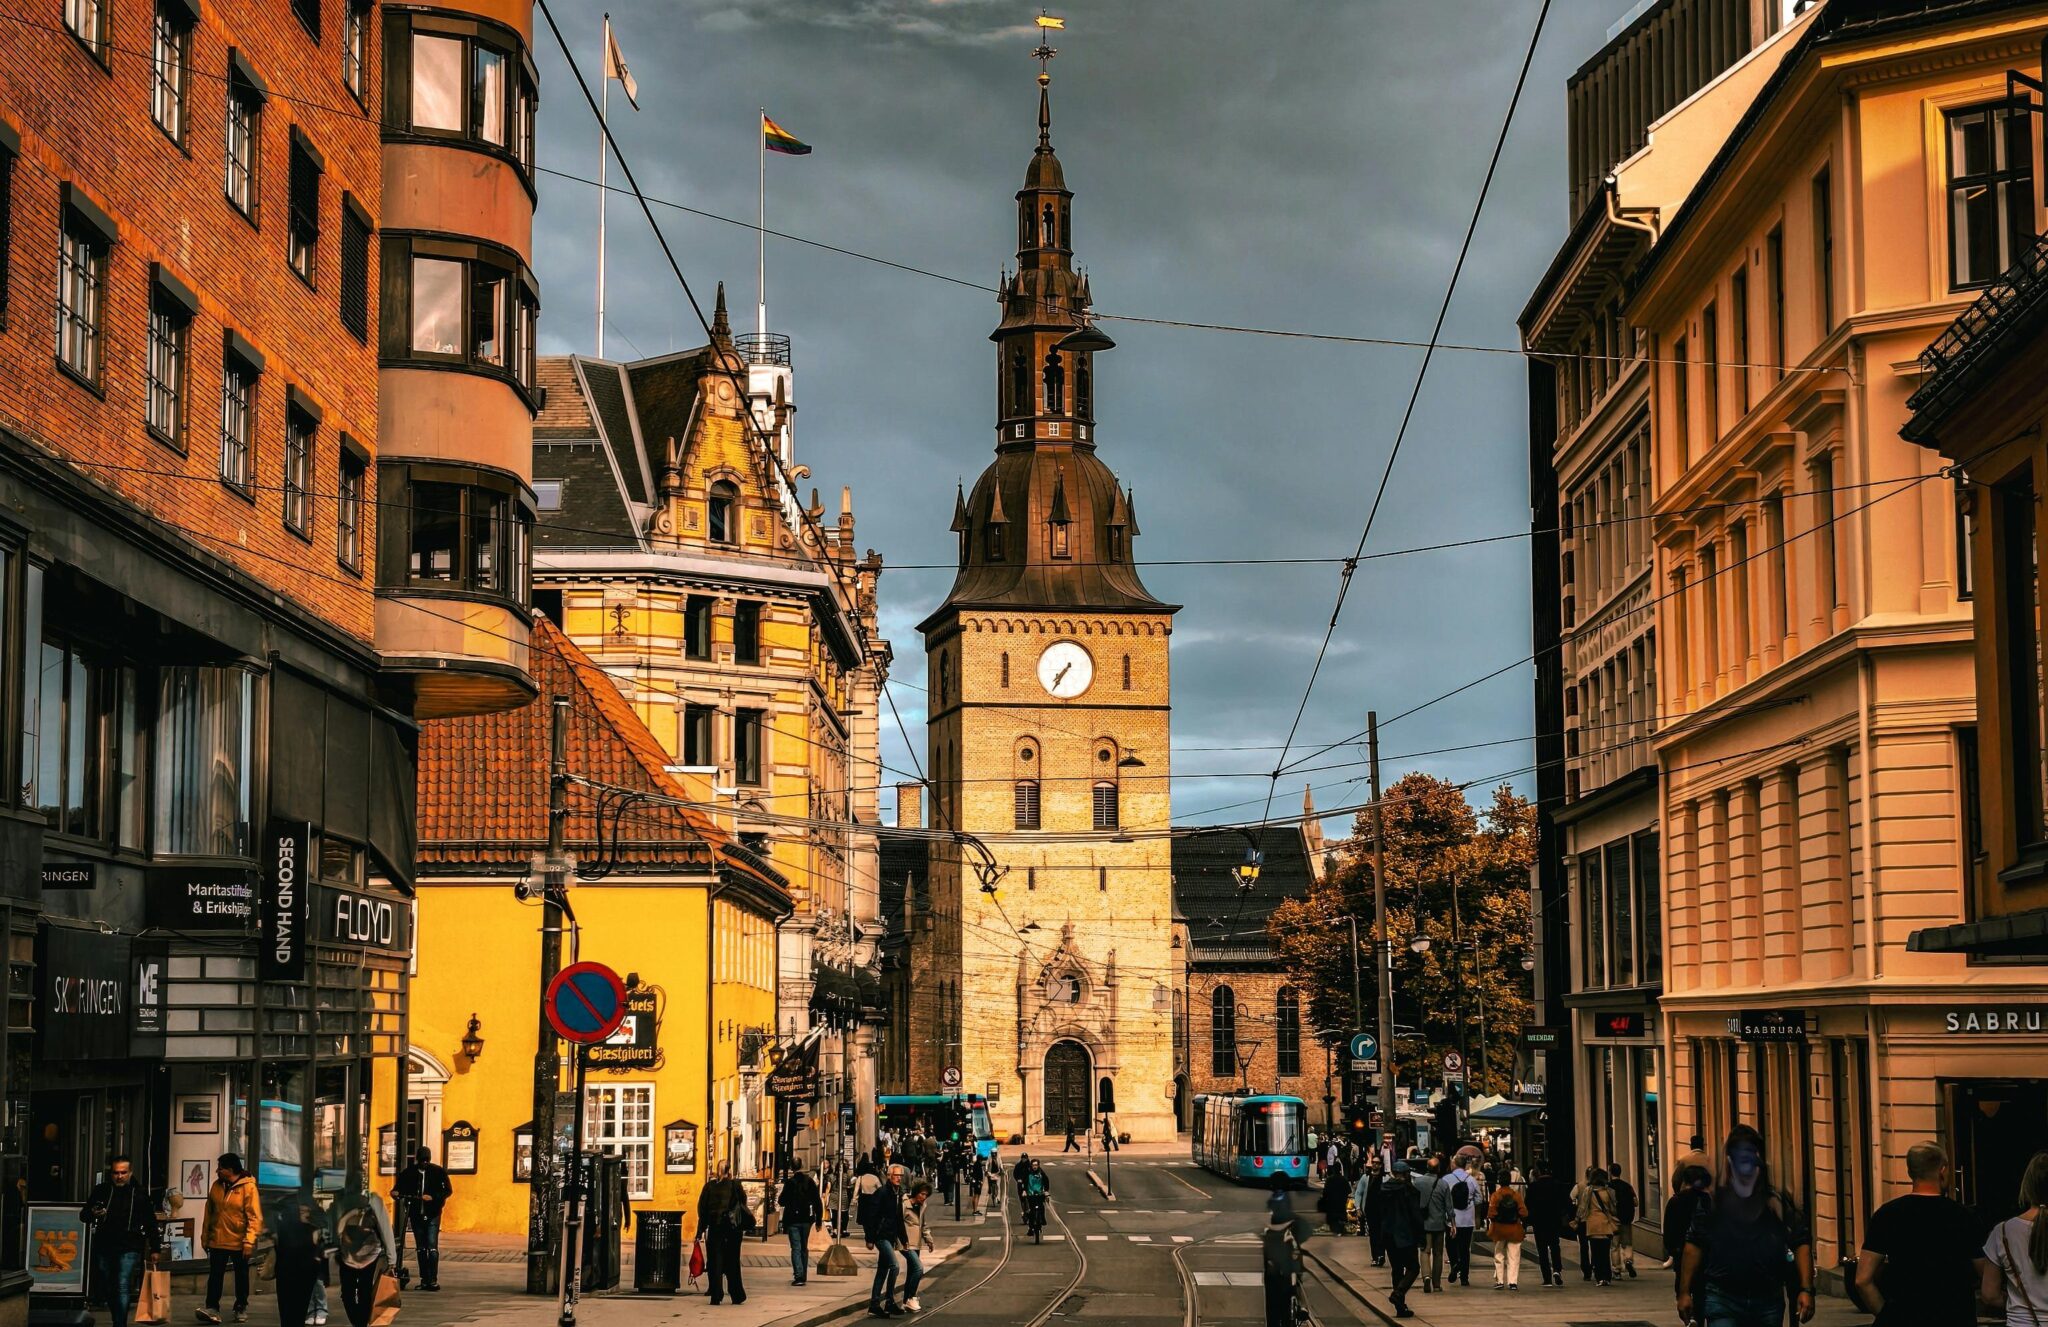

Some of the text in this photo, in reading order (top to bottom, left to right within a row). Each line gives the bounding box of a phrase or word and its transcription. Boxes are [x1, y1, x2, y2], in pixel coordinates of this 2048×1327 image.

[276, 837, 294, 964] SECOND HAND
[336, 894, 392, 945] FLOYD
[1744, 1025, 1803, 1035] SABRURA
[1946, 1011, 2041, 1031] SABRU
